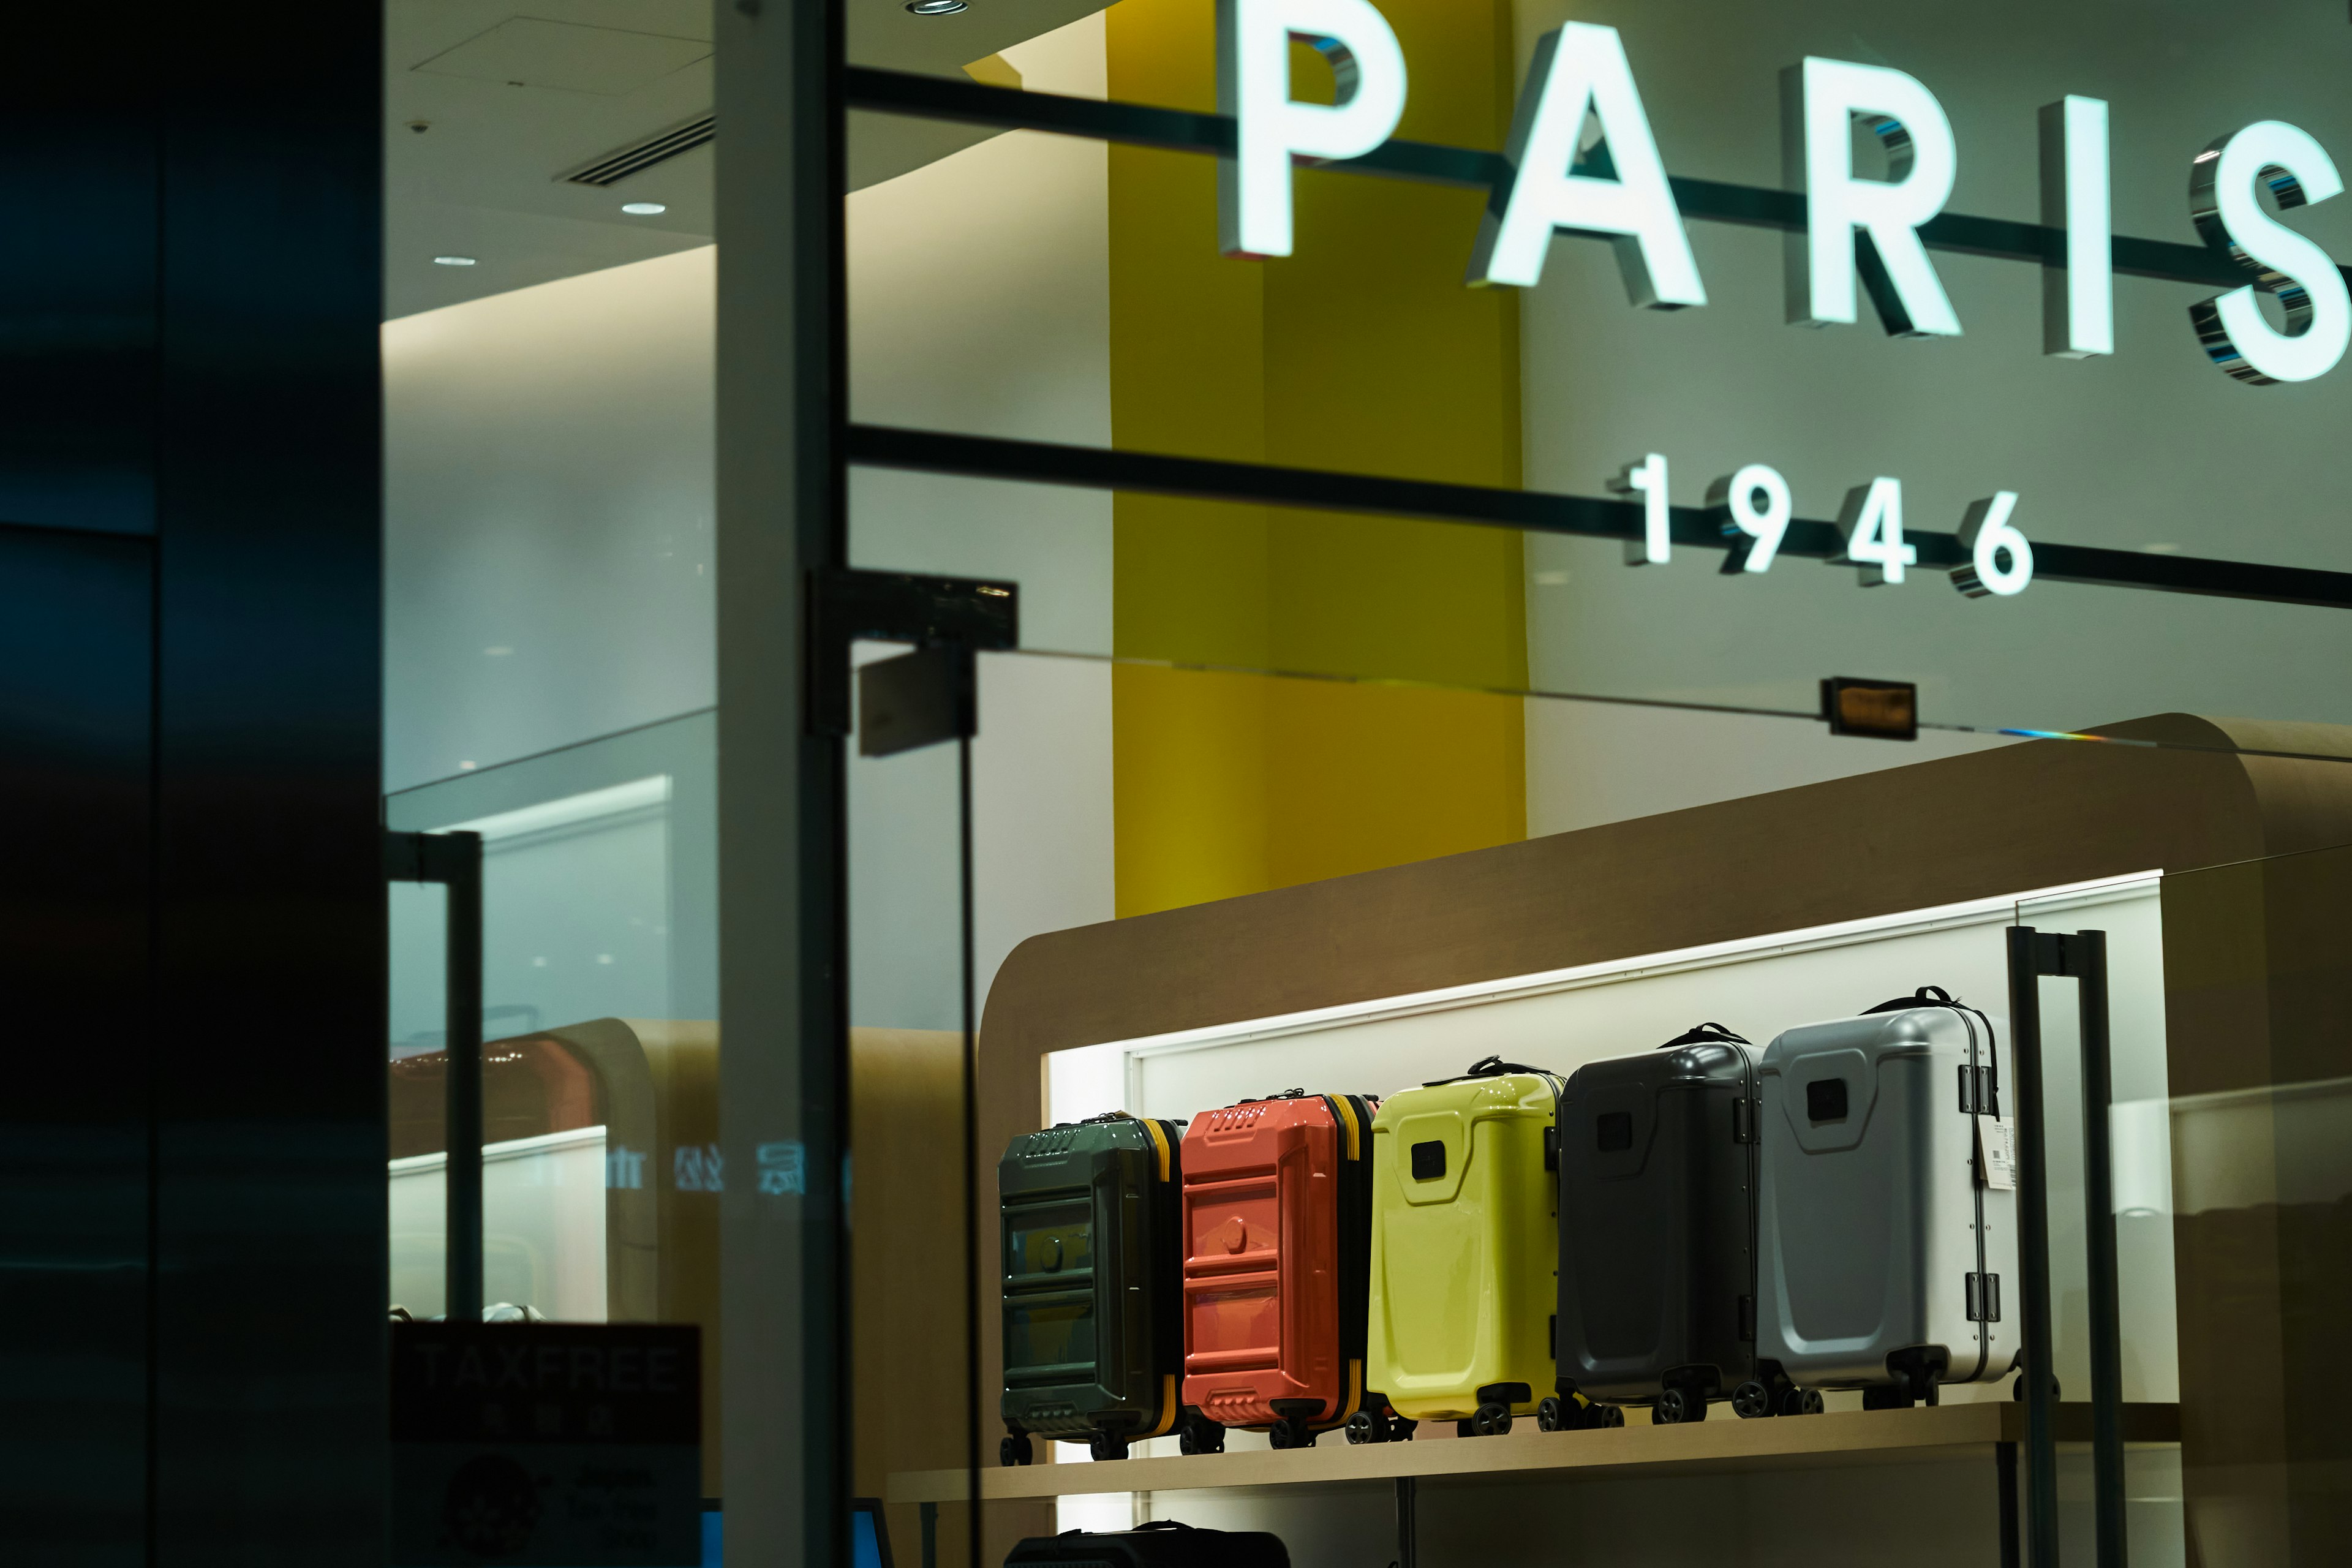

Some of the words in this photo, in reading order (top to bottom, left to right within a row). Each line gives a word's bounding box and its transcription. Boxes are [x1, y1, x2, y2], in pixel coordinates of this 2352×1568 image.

[1236, 0, 2352, 382] PARIS
[1629, 453, 2034, 596] 1946
[413, 1342, 679, 1393] TAXFREE
